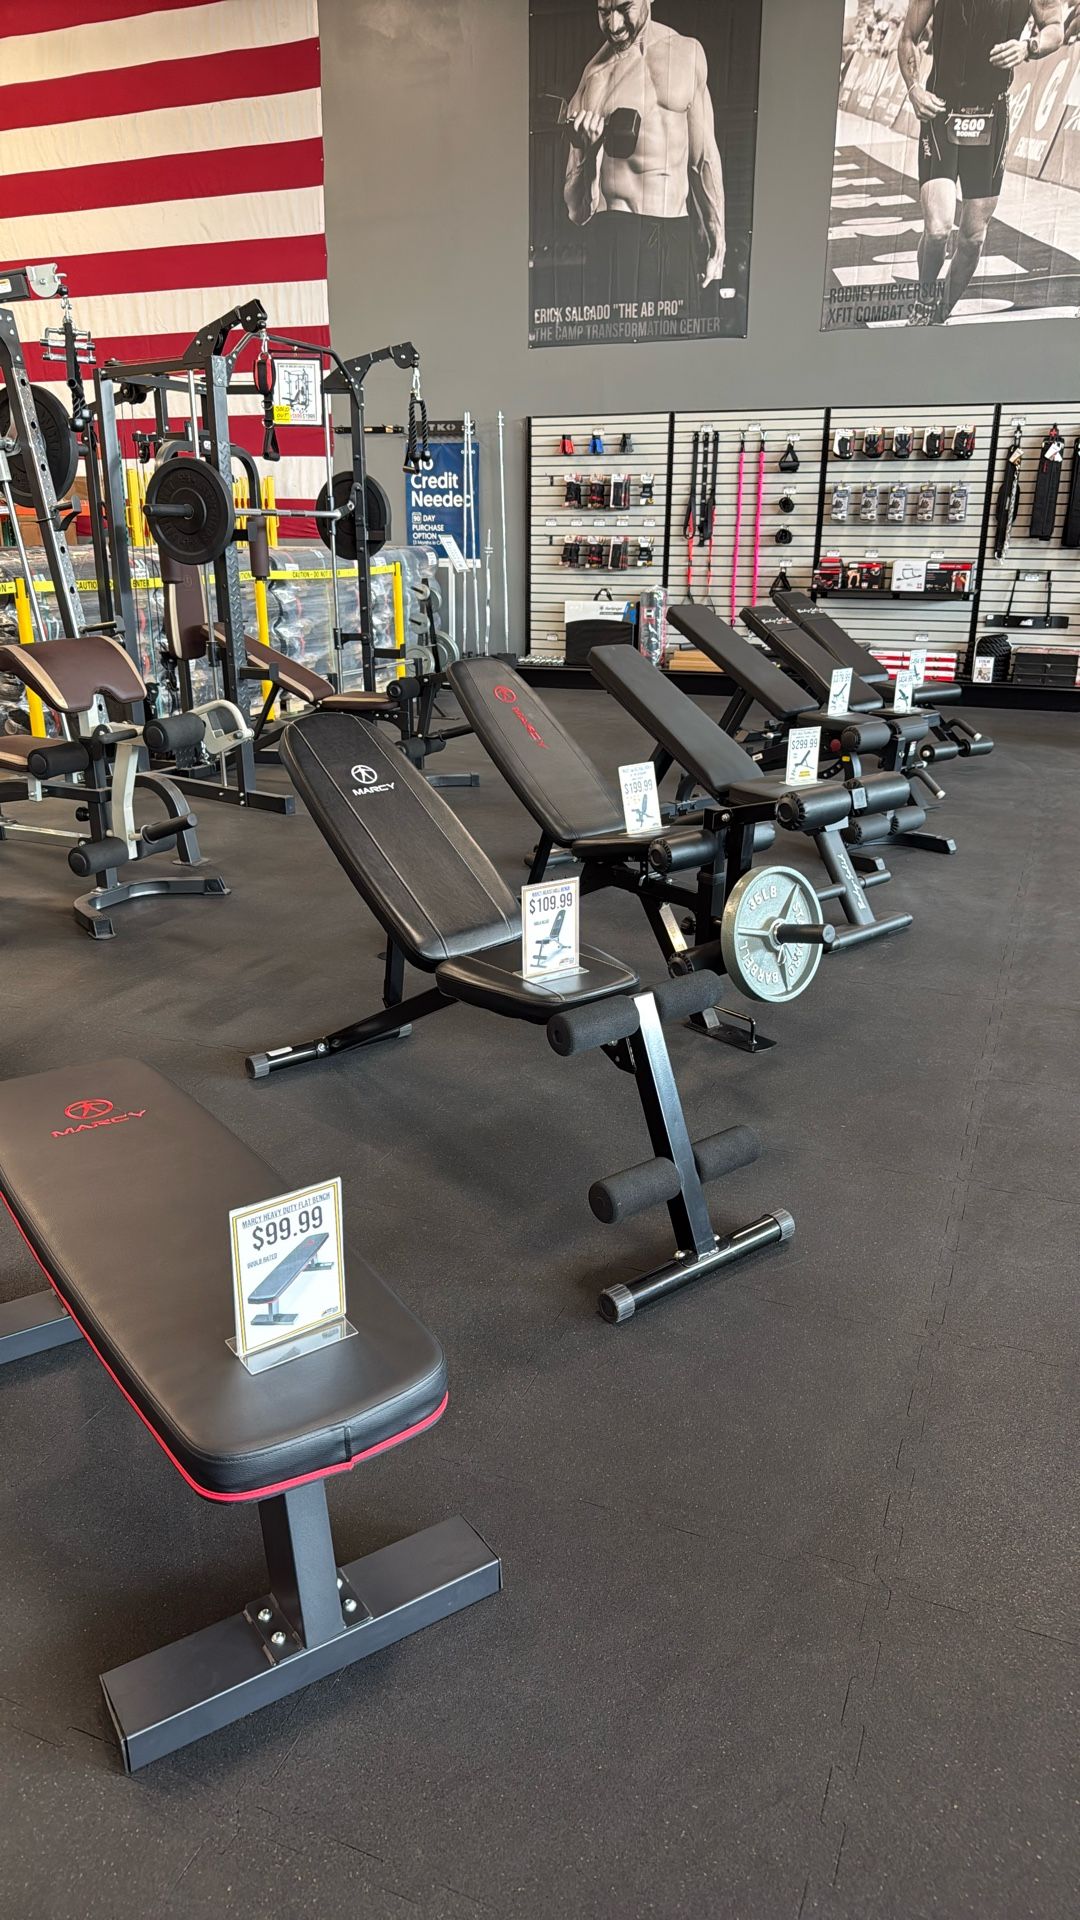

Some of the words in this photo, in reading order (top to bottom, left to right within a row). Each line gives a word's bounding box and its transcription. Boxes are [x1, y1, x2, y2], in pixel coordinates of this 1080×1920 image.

[953, 118, 986, 131] 2600
[829, 285, 875, 304] RODNEY
[878, 281, 946, 301] HICKERSON
[534, 306, 563, 324] ERICK
[564, 304, 611, 322] SALGADO
[612, 302, 639, 319] "THE
[640, 301, 655, 317] AB
[657, 299, 684, 316] PRO"
[828, 306, 853, 324] XFIT
[856, 304, 904, 322] COMBAT
[534, 326, 553, 342] THE
[555, 324, 584, 341] CAMP
[585, 319, 678, 340] TRANSFORMATION
[679, 317, 721, 334] CENTER
[410, 471, 459, 489] Credit
[422, 514, 436, 522] DAY
[412, 524, 445, 532] PURCHASE
[412, 532, 437, 540] OPTION
[76, 579, 98, 591] CAUTIO
[791, 738, 818, 750] $299.99
[351, 782, 395, 797] MARCY
[624, 778, 653, 795] $199.99
[529, 892, 573, 916] $109.99
[739, 940, 780, 985] BARBELL
[50, 1109, 147, 1139] MARCY
[241, 1215, 262, 1230] MARCY
[263, 1208, 282, 1222] HEAVY
[282, 1203, 298, 1216] DUTY
[298, 1197, 313, 1211] FLAT
[312, 1191, 331, 1205] BENCH
[252, 1205, 323, 1252] $99.99
